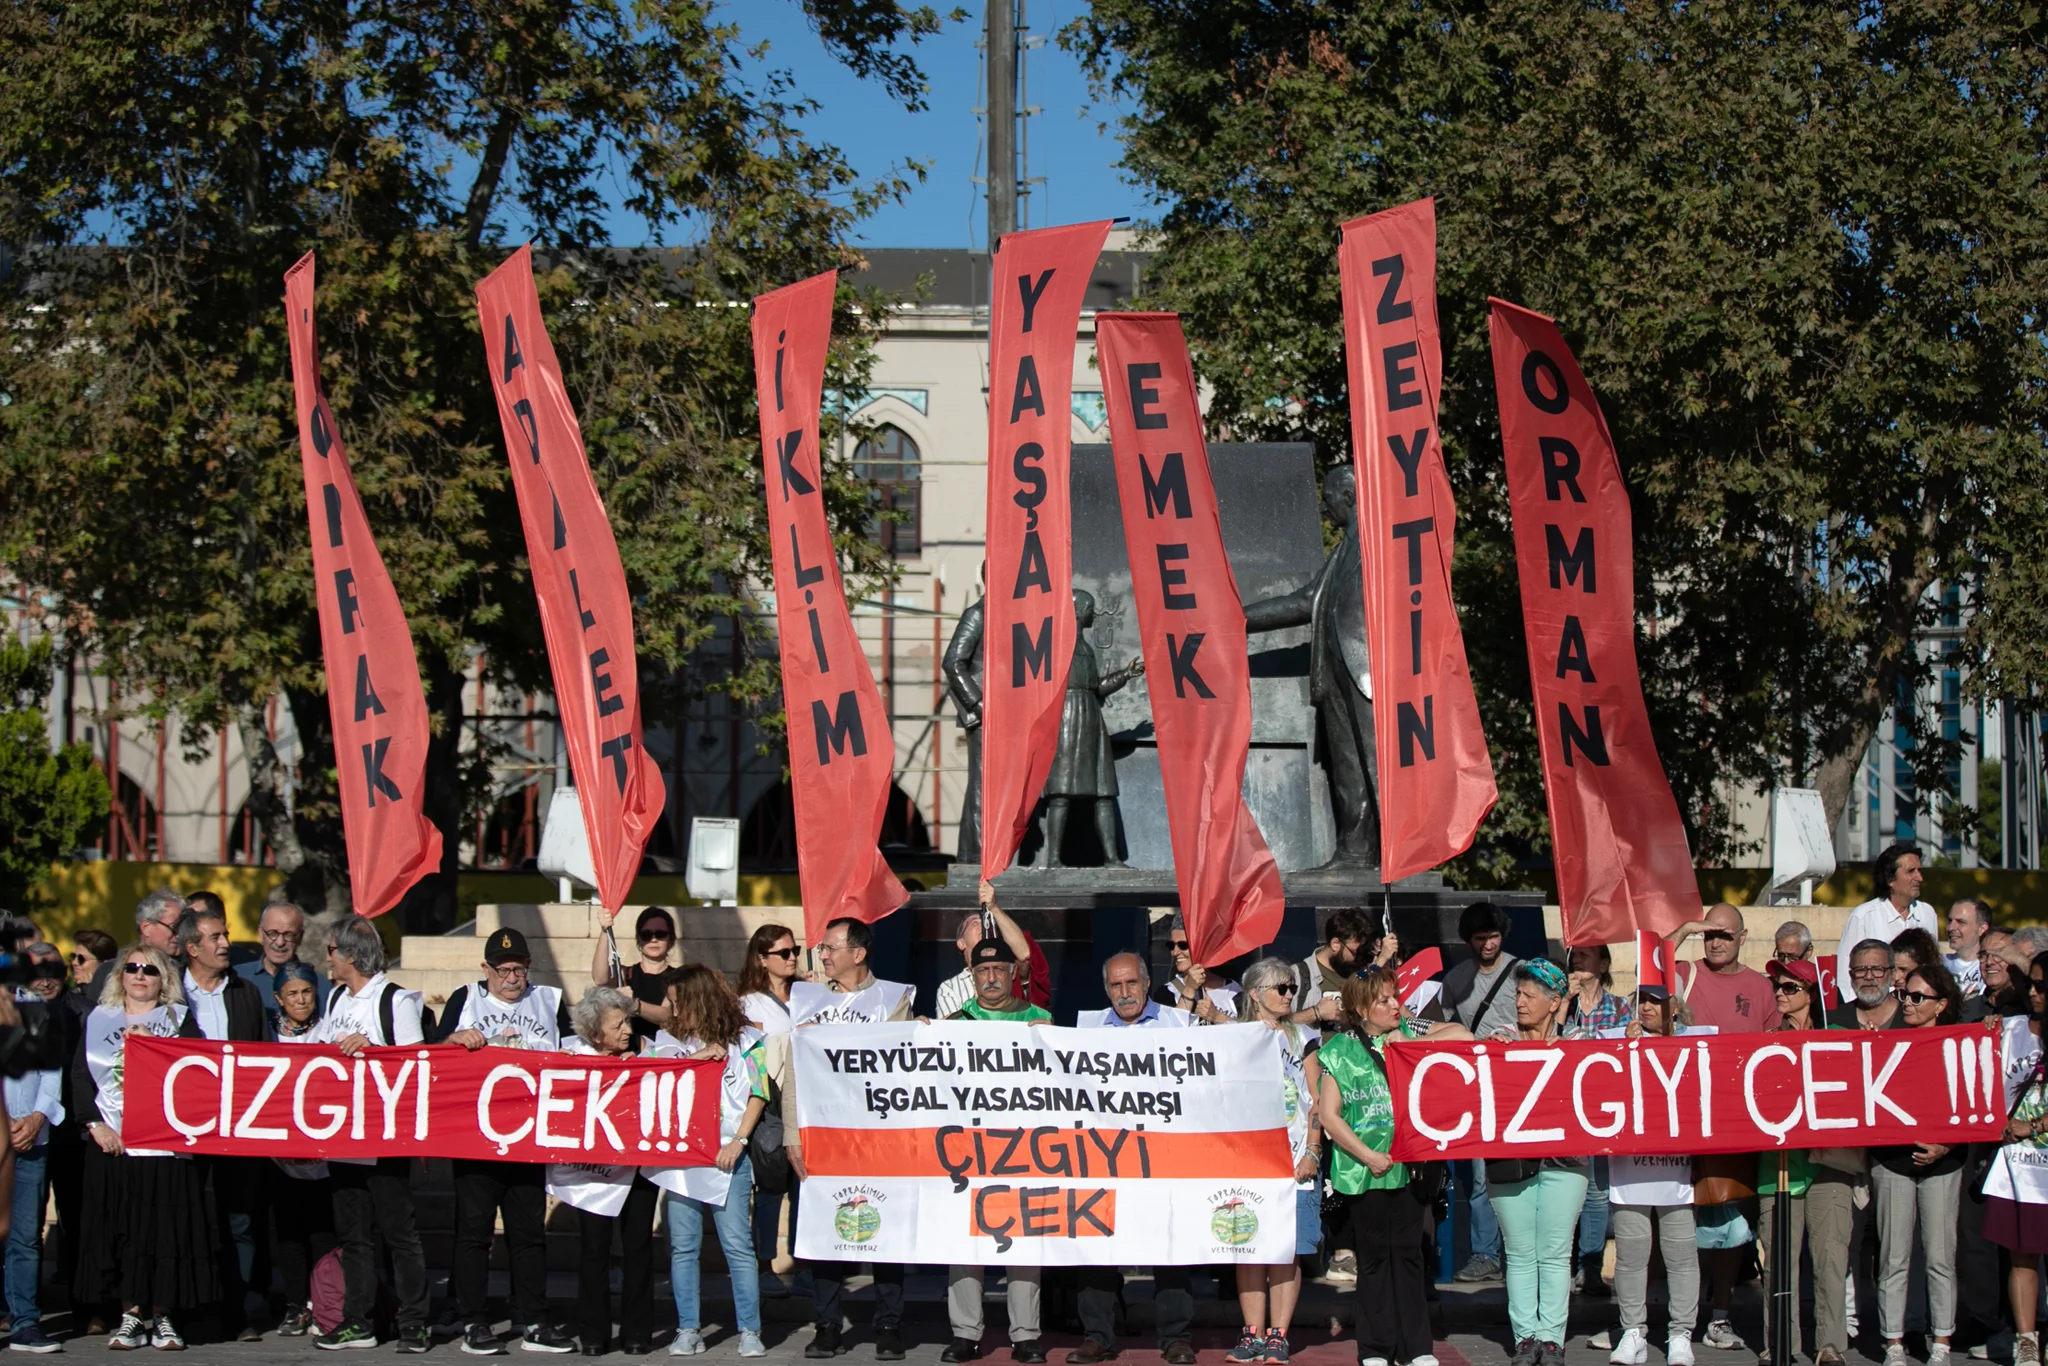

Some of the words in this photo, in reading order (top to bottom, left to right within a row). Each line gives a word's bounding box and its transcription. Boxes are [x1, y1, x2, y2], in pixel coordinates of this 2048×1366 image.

[1011, 268, 1057, 688] YAŞAM
[1127, 363, 1217, 699] EMEK
[1372, 254, 1437, 767] ZEYTİN
[774, 329, 867, 767] İKLİM
[1521, 349, 1611, 767] ORMAN
[163, 1044, 431, 1146] ÇİZGİYİ
[824, 1041, 964, 1075] YERYÜZÜ,
[966, 1041, 1052, 1075] İKLİM,
[1054, 1050, 1156, 1084] YAŞAM
[1159, 1046, 1216, 1084] İÇİN
[865, 1081, 948, 1120] İŞGAL
[951, 1086, 1095, 1112] YASASINA
[1097, 1090, 1182, 1123] KARŞI
[1408, 1040, 1713, 1151] ÇİZGİYİ
[1744, 1040, 1918, 1145] ÇEK
[935, 1117, 1151, 1194] ÇİZGİYİ
[975, 1184, 1114, 1254] ÇEK
